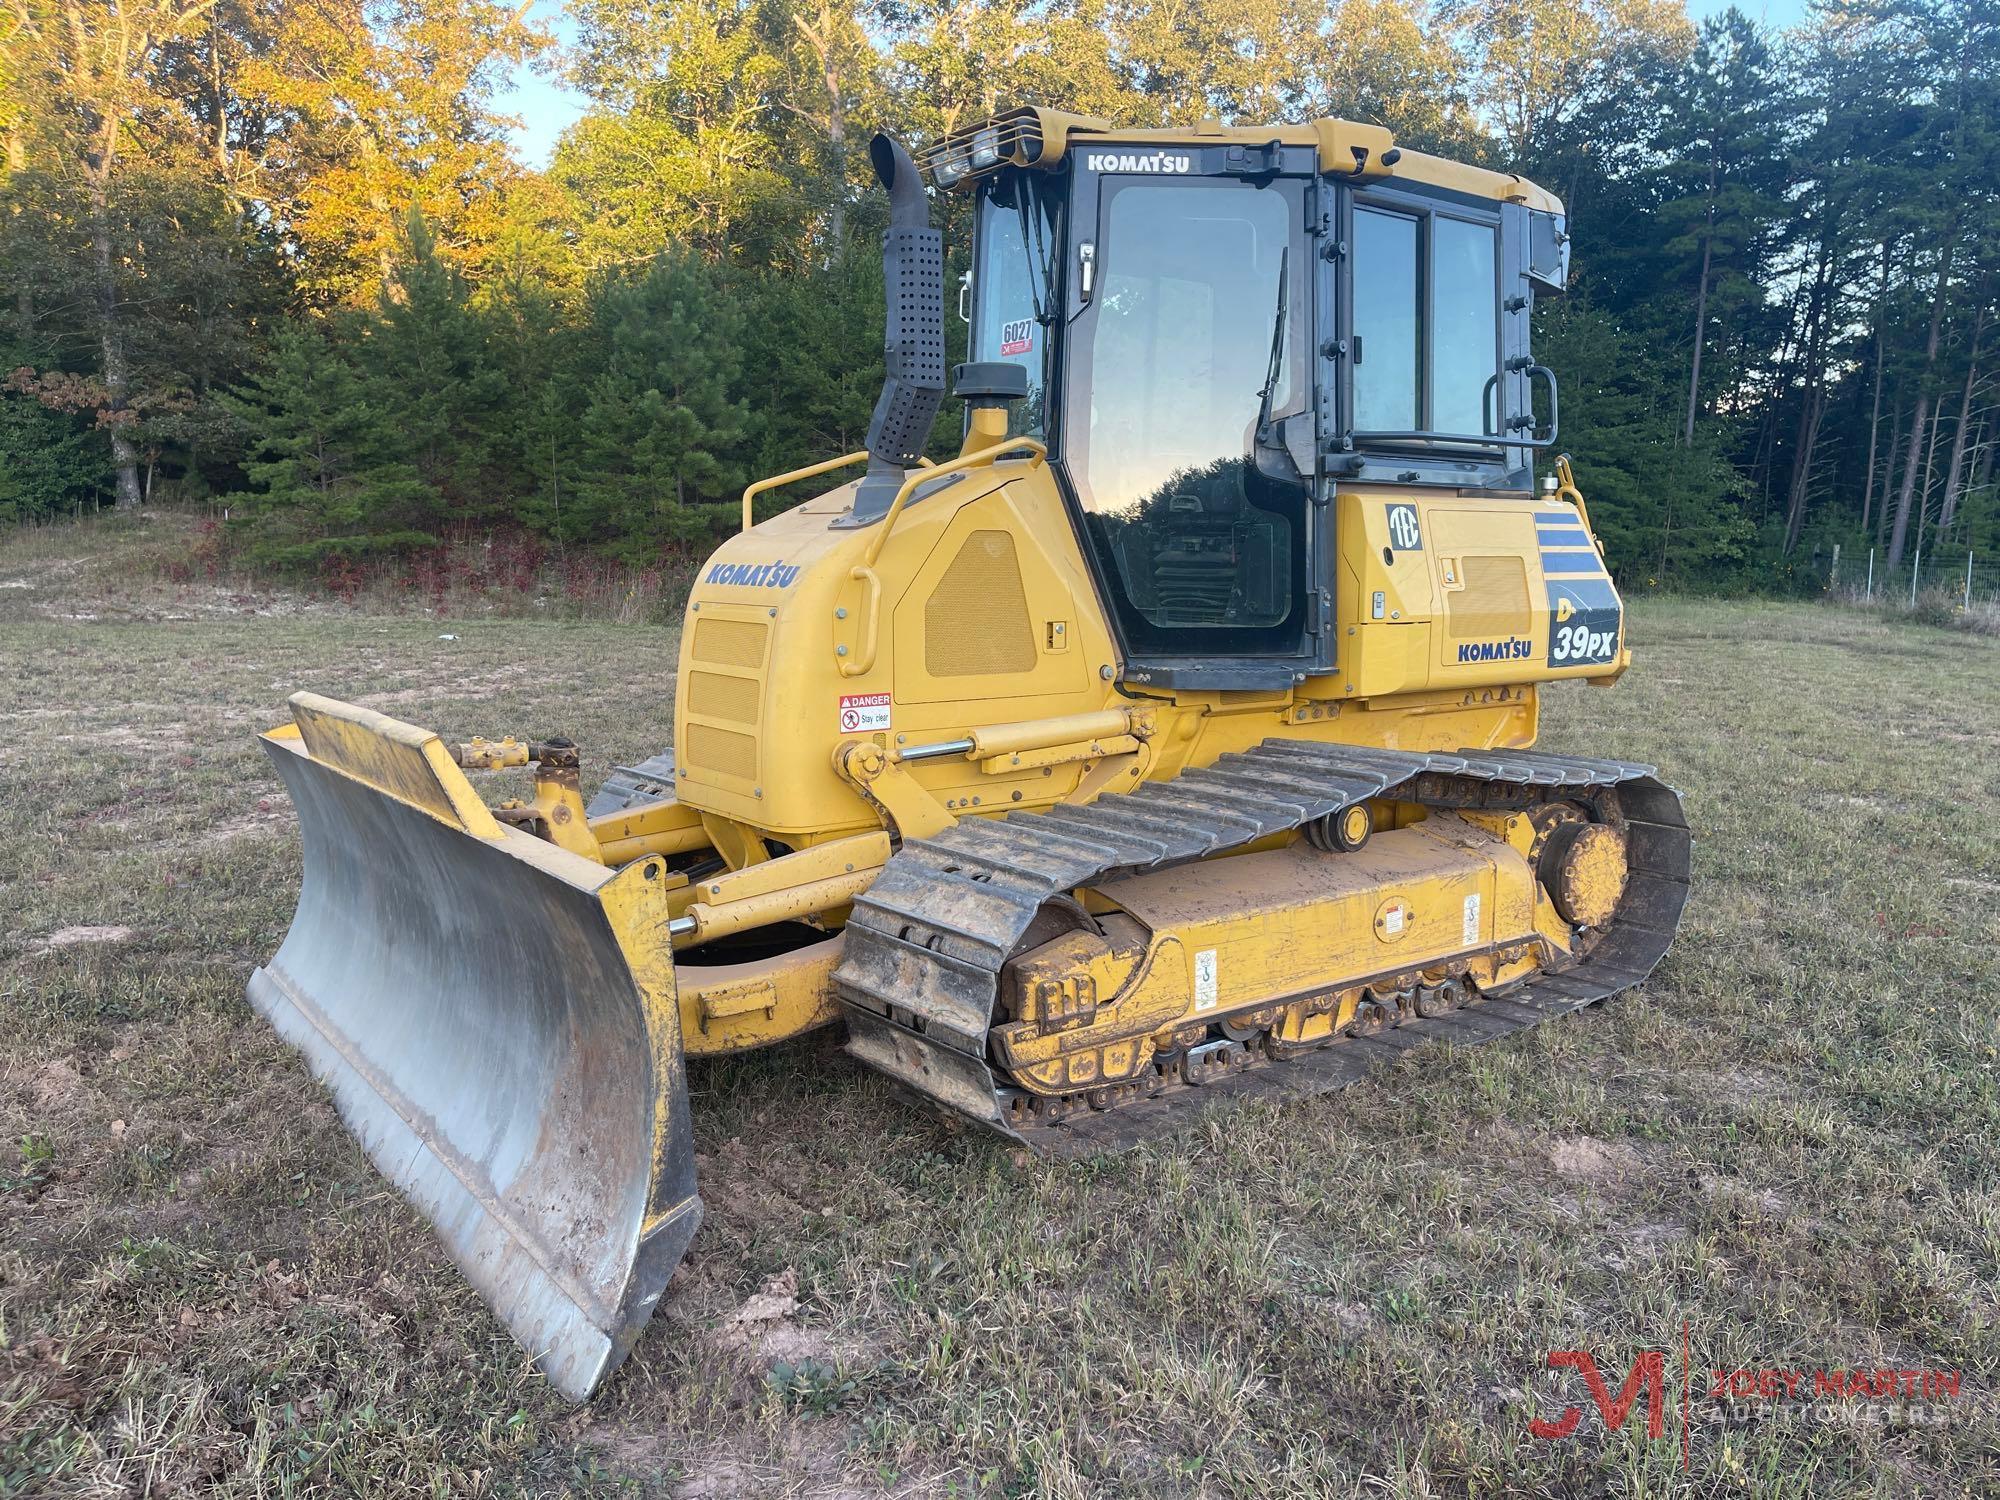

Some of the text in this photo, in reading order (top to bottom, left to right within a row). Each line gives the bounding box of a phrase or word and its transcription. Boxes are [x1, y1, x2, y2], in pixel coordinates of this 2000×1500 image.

[1088, 152, 1190, 173] KOMATSU
[1004, 320, 1032, 343] 6027
[705, 560, 801, 588] KOMATSU
[1458, 636, 1532, 662] KOMATSU
[1553, 625, 1615, 660] 39PX
[852, 695, 890, 707] DANGER
[861, 713, 889, 724] Stay clear
